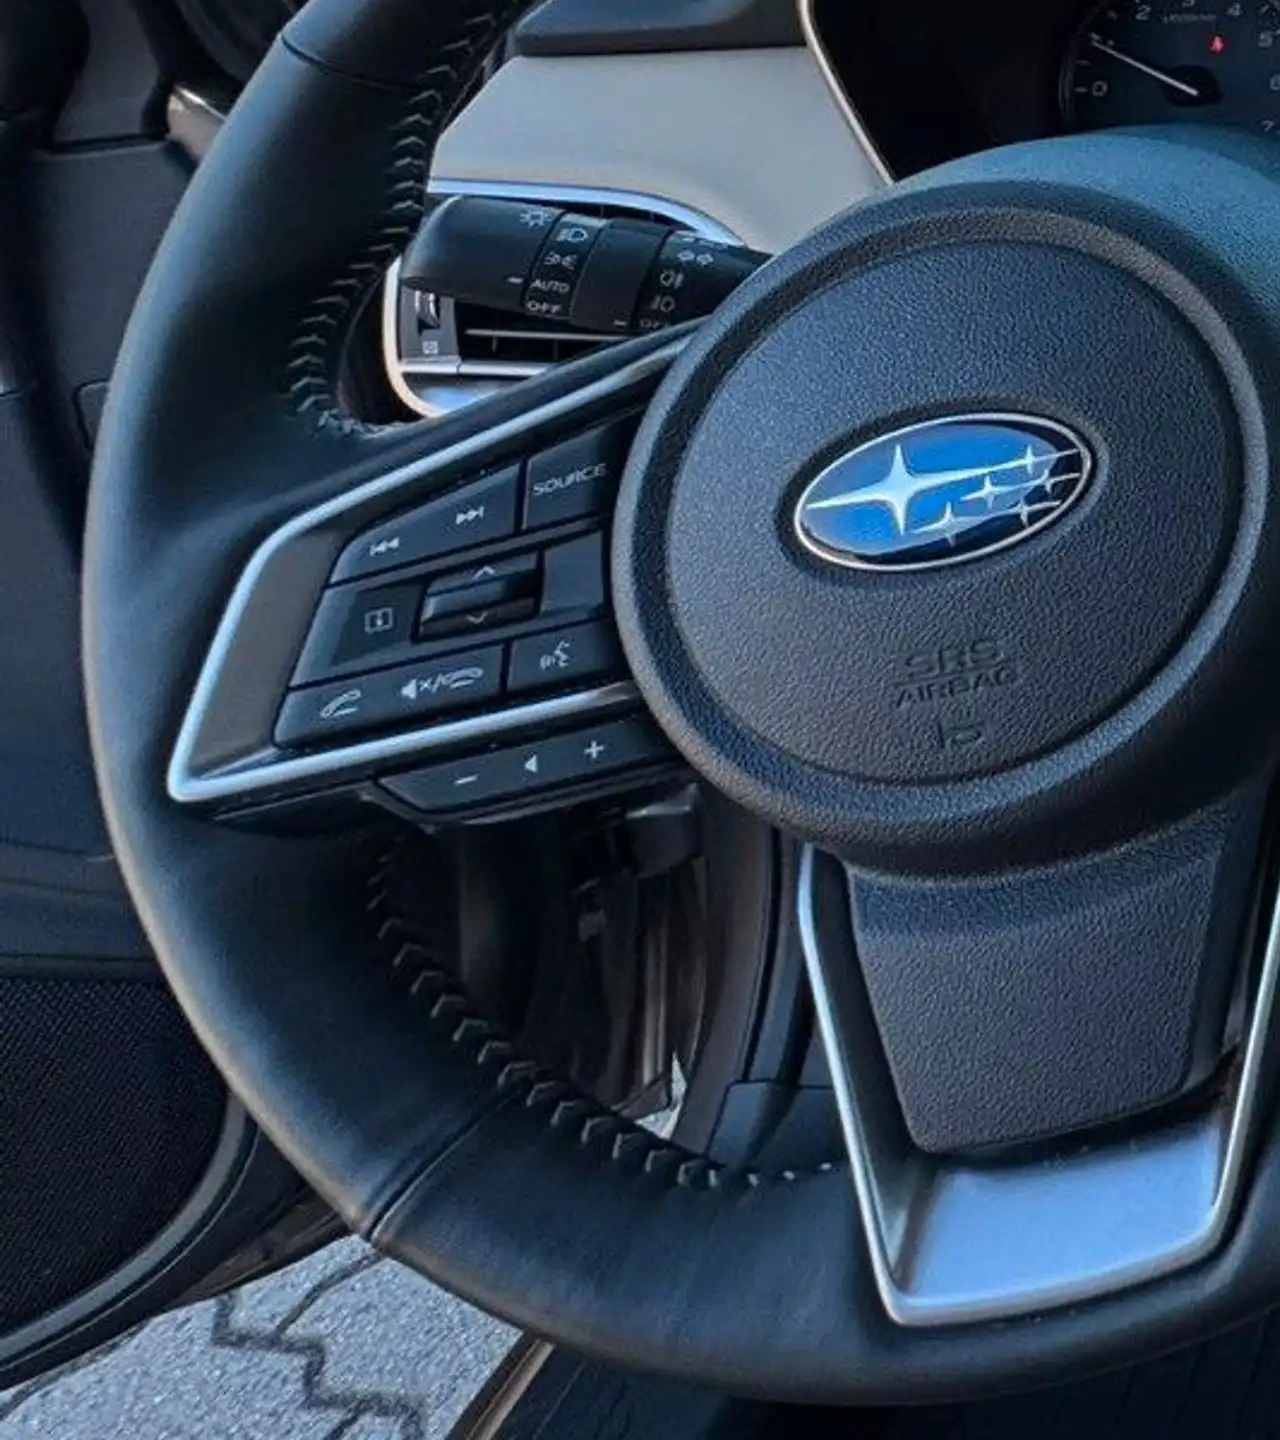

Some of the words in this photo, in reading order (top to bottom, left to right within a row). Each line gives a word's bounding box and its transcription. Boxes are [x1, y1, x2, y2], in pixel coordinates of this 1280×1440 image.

[1134, 5, 1151, 21] 2
[1226, 1, 1243, 17] 4
[1257, 31, 1274, 48] 5
[1092, 80, 1108, 97] 0
[529, 278, 571, 294] AUTO
[524, 299, 562, 314] OFF
[531, 462, 608, 497] SOURCE
